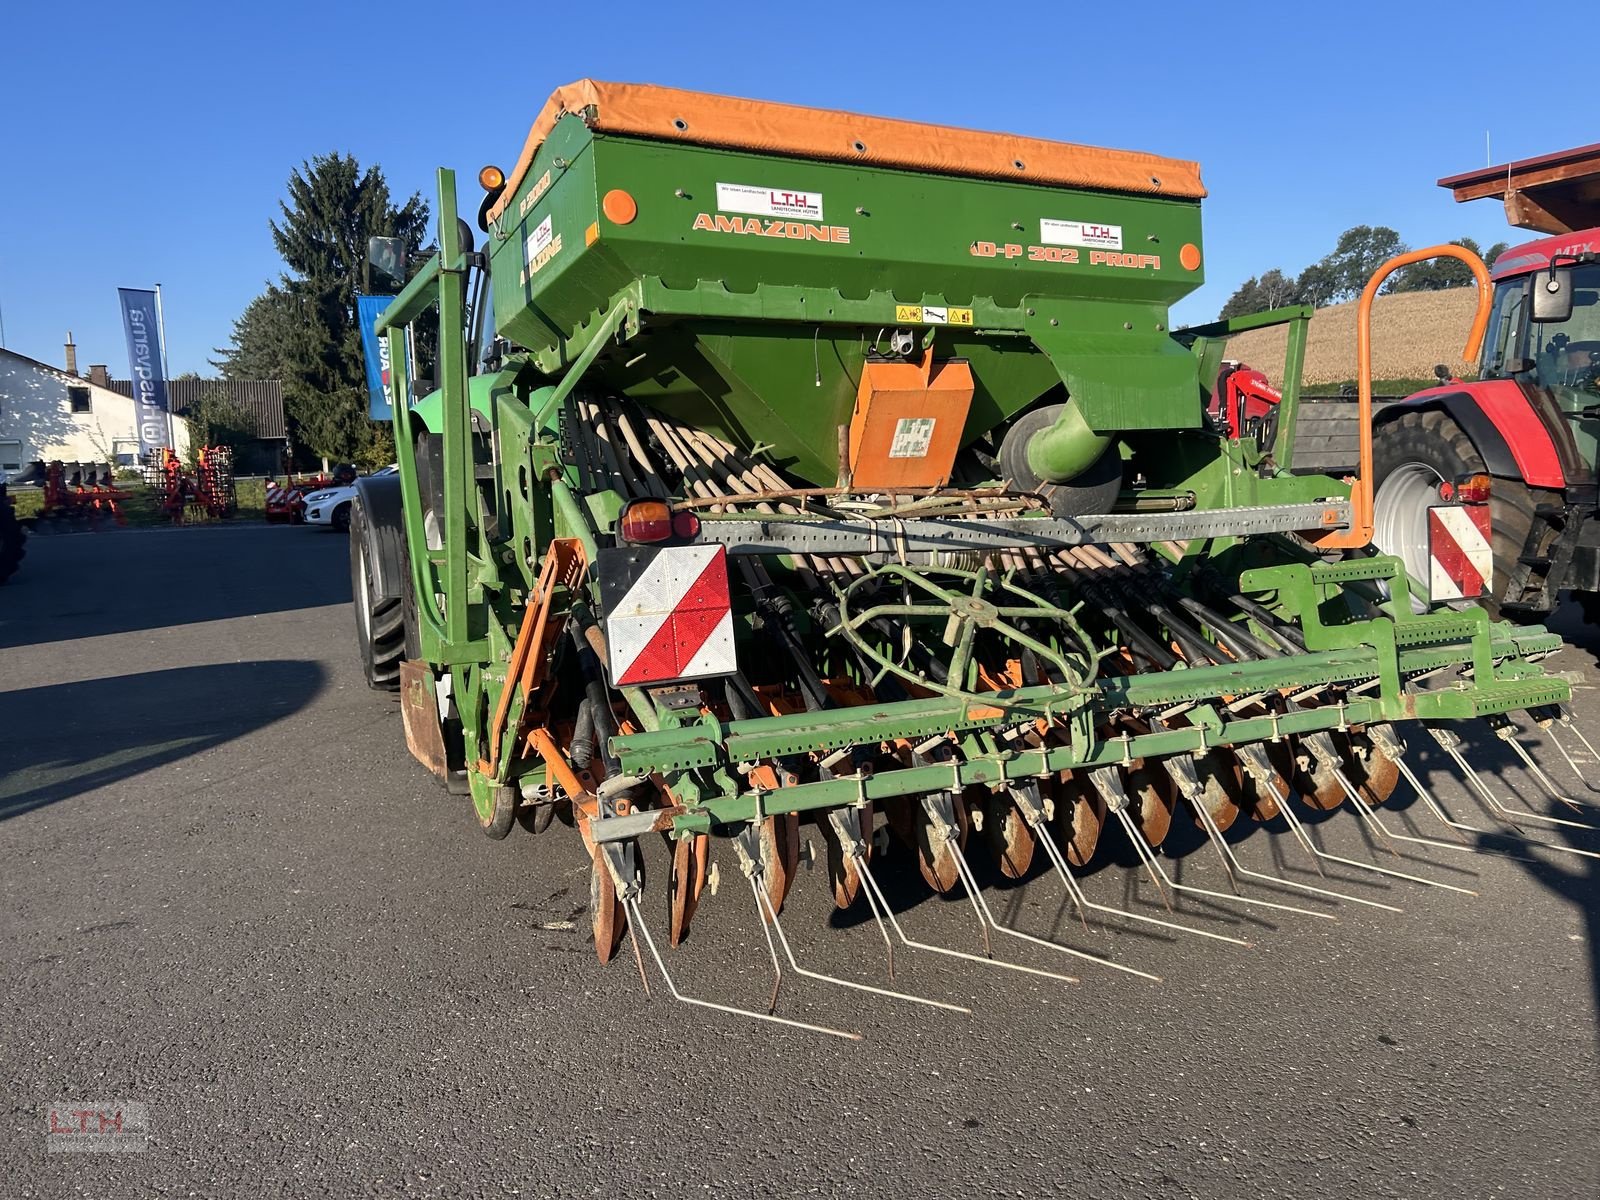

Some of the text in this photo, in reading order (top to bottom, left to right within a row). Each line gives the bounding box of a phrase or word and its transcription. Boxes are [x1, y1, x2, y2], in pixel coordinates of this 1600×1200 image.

[692, 213, 851, 244] AMAZONE
[519, 233, 562, 288] AMAZONE
[1028, 245, 1080, 264] 302
[1089, 250, 1161, 270] PROFI
[1555, 241, 1594, 256] MTX
